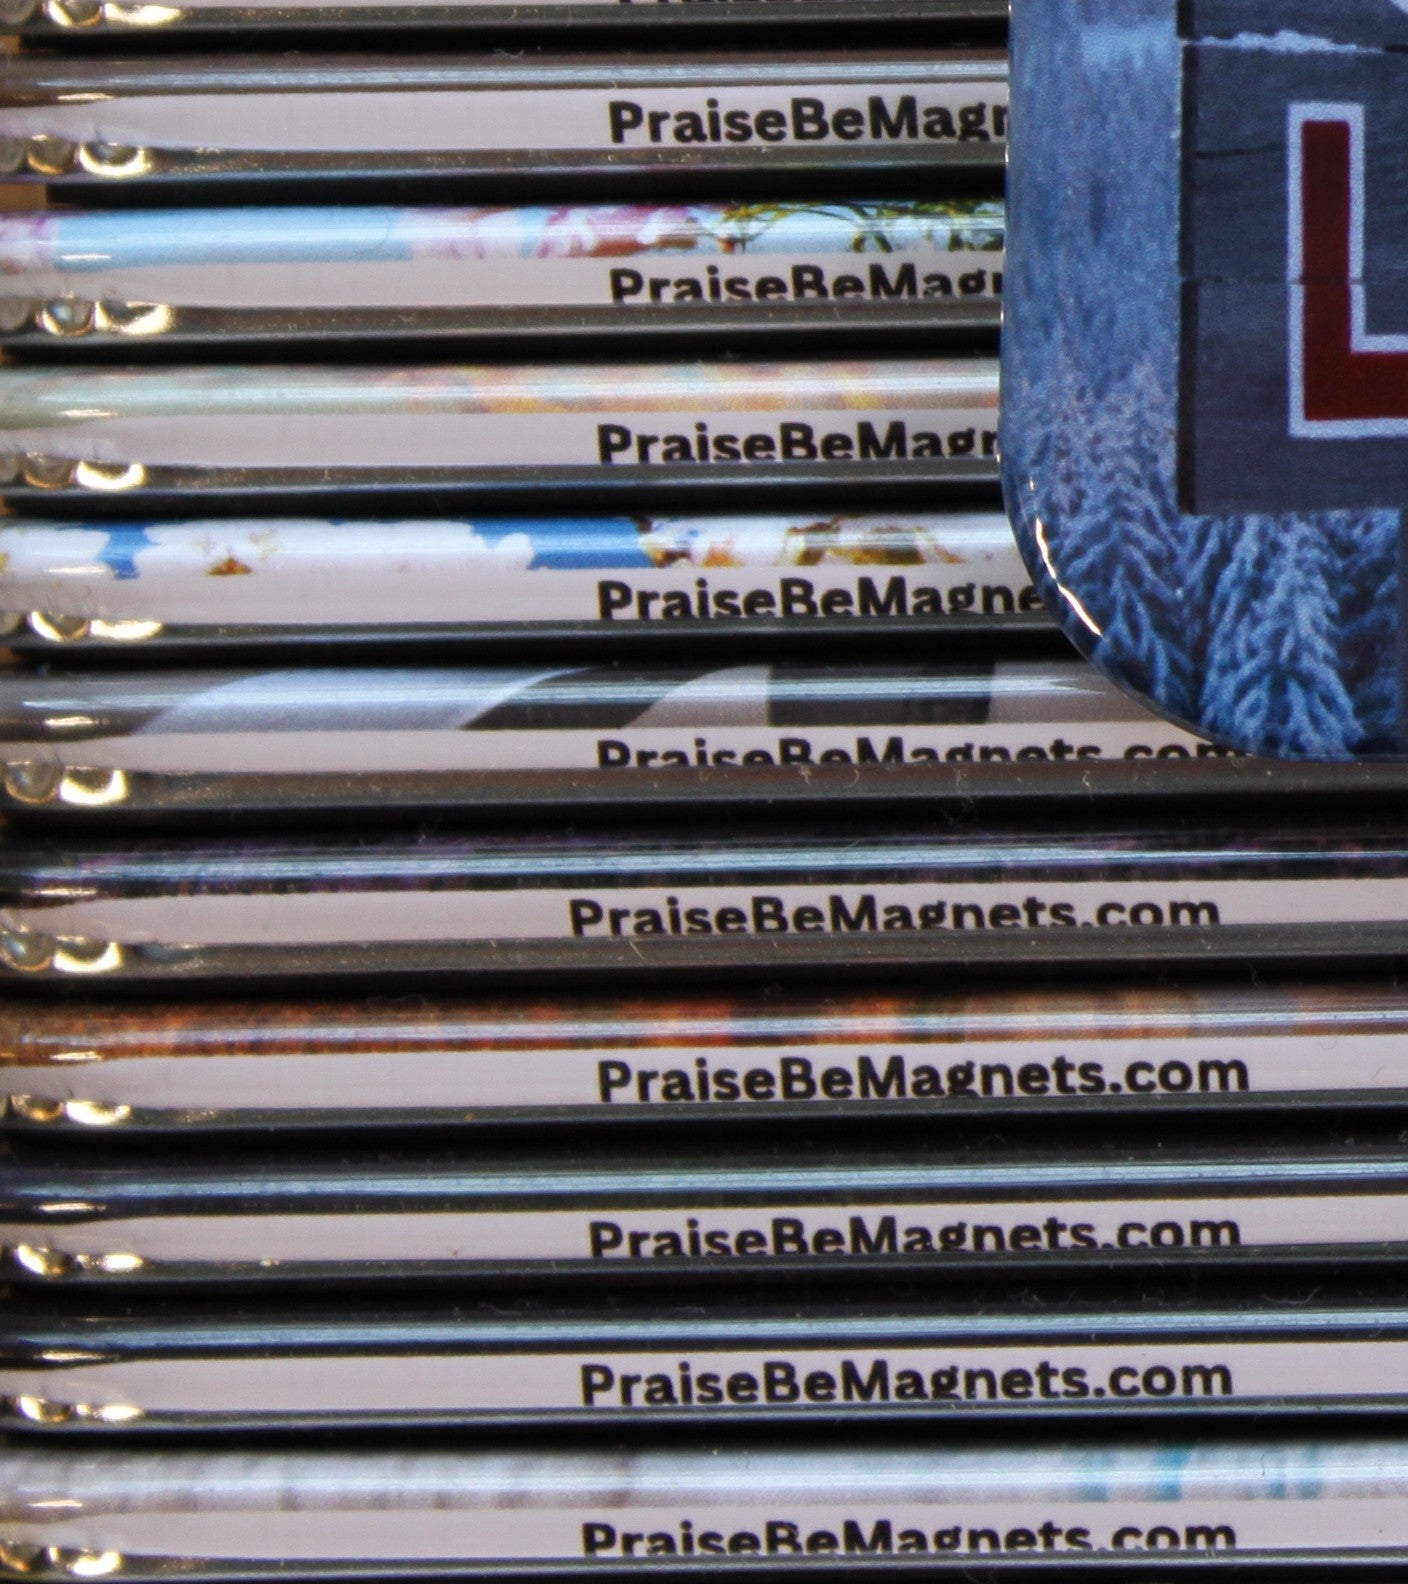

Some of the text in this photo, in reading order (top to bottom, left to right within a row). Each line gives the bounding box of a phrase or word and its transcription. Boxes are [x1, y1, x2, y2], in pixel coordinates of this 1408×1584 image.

[598, 576, 1042, 621] PraiseBeMagne
[570, 894, 1220, 937] PraiseBeMagnets.com
[599, 1056, 1249, 1103] PraiseBeMagnets.com
[589, 1216, 1241, 1257] PraiseBeMagnets.com
[581, 1359, 1232, 1405] PraiseBeMagnets.com
